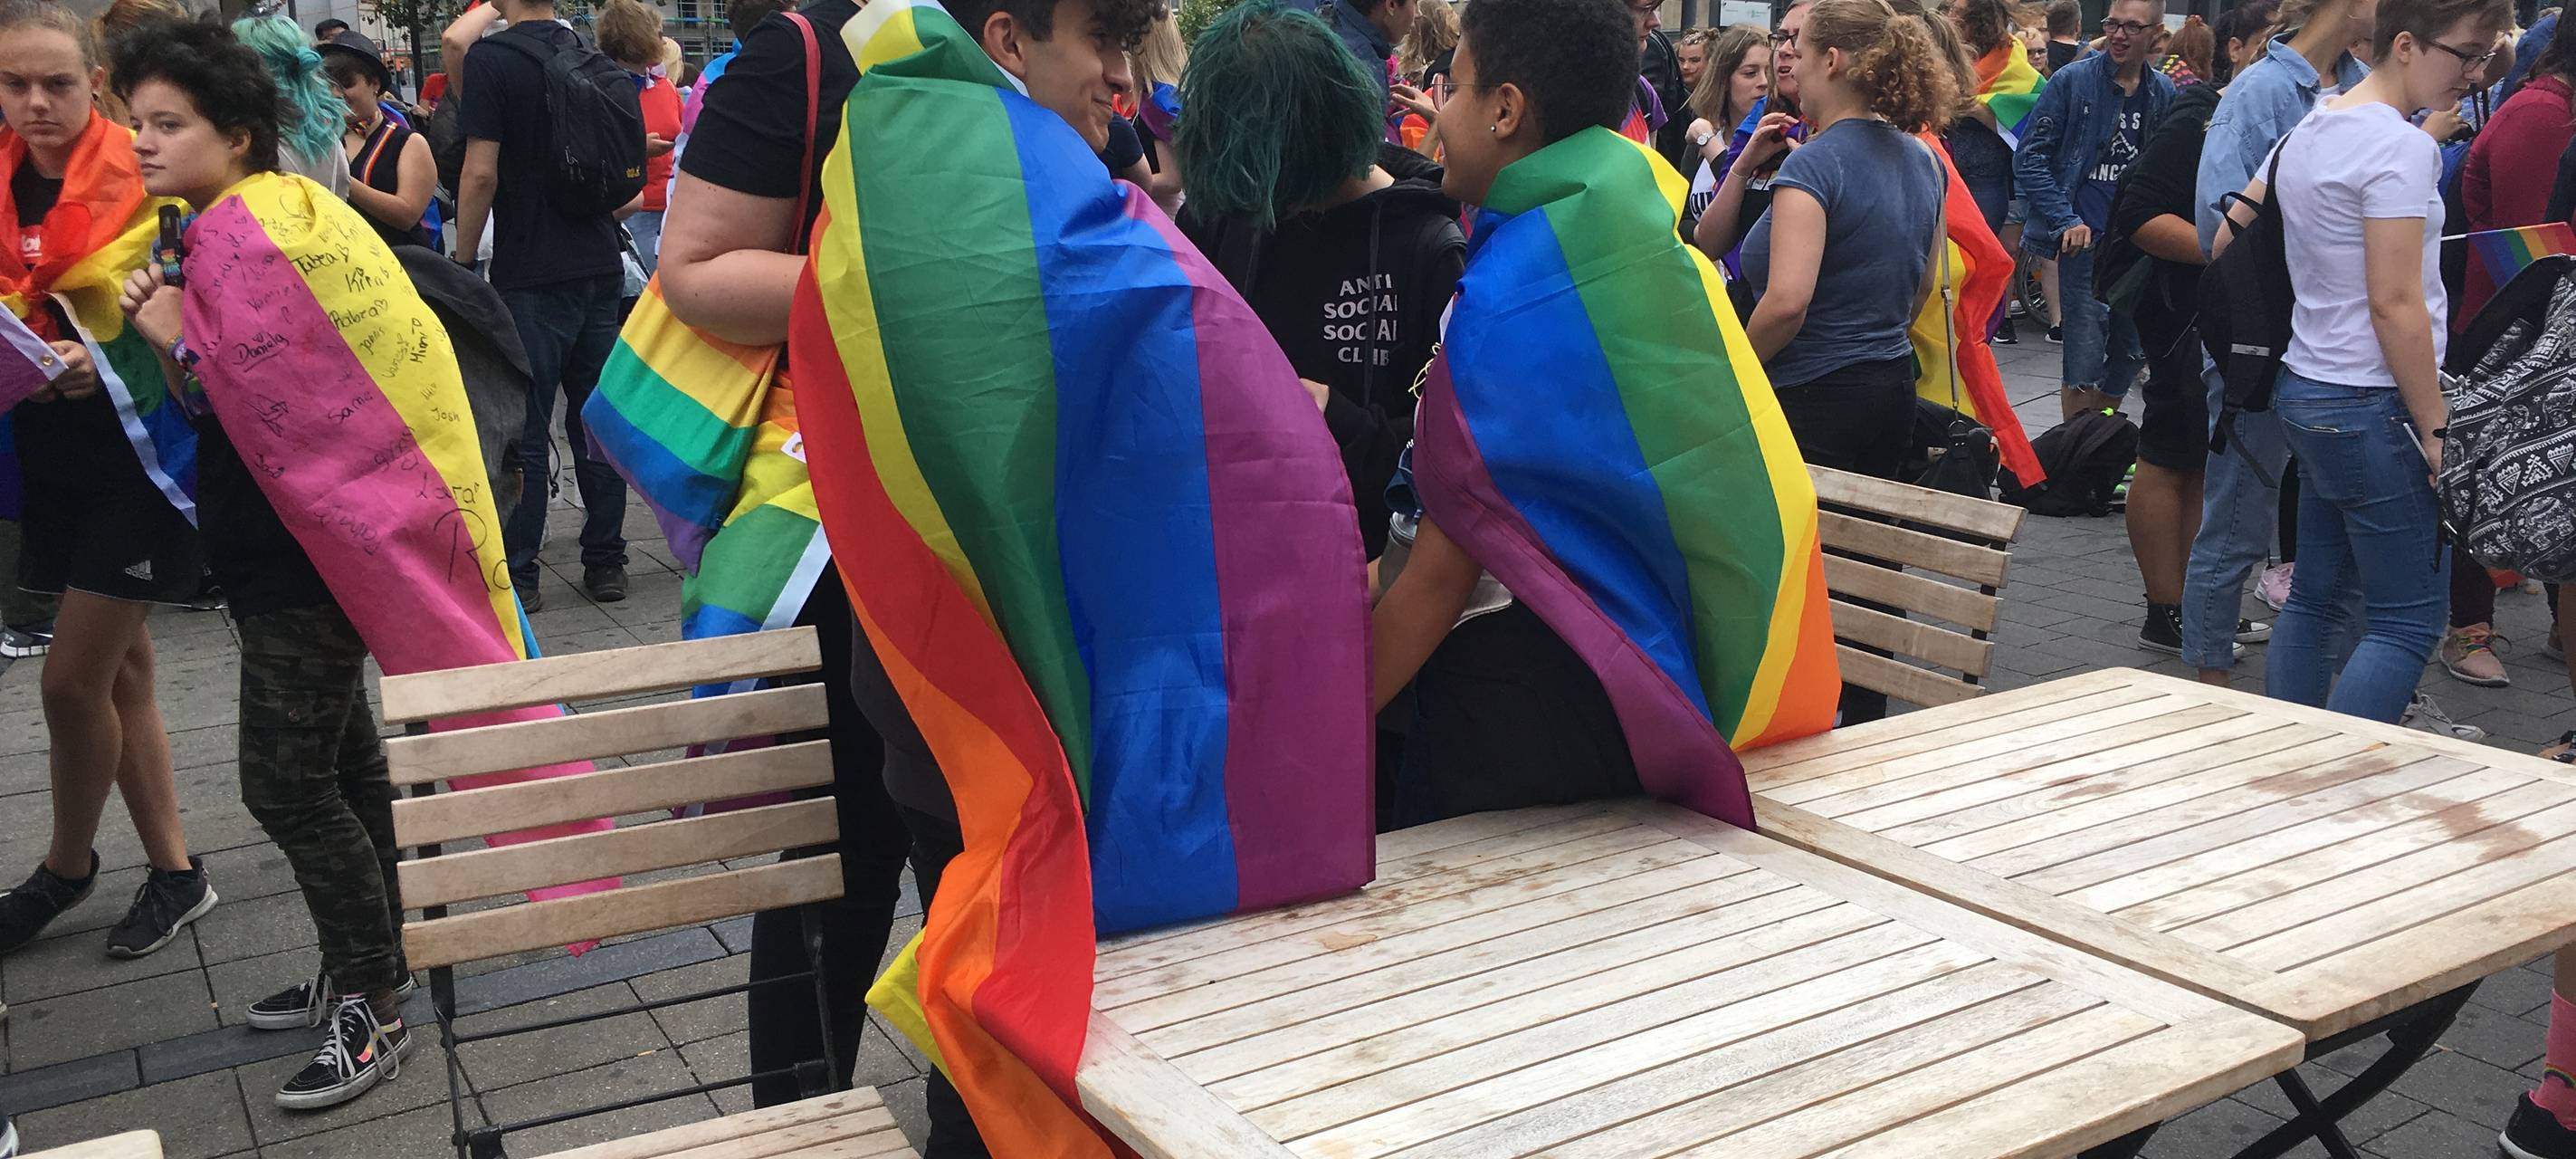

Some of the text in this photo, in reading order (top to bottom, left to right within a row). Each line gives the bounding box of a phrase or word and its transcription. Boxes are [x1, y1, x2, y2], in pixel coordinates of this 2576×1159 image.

[1339, 273, 1392, 297] ANTI
[1323, 319, 1397, 341] SOCA
[430, 407, 462, 422] Josh
